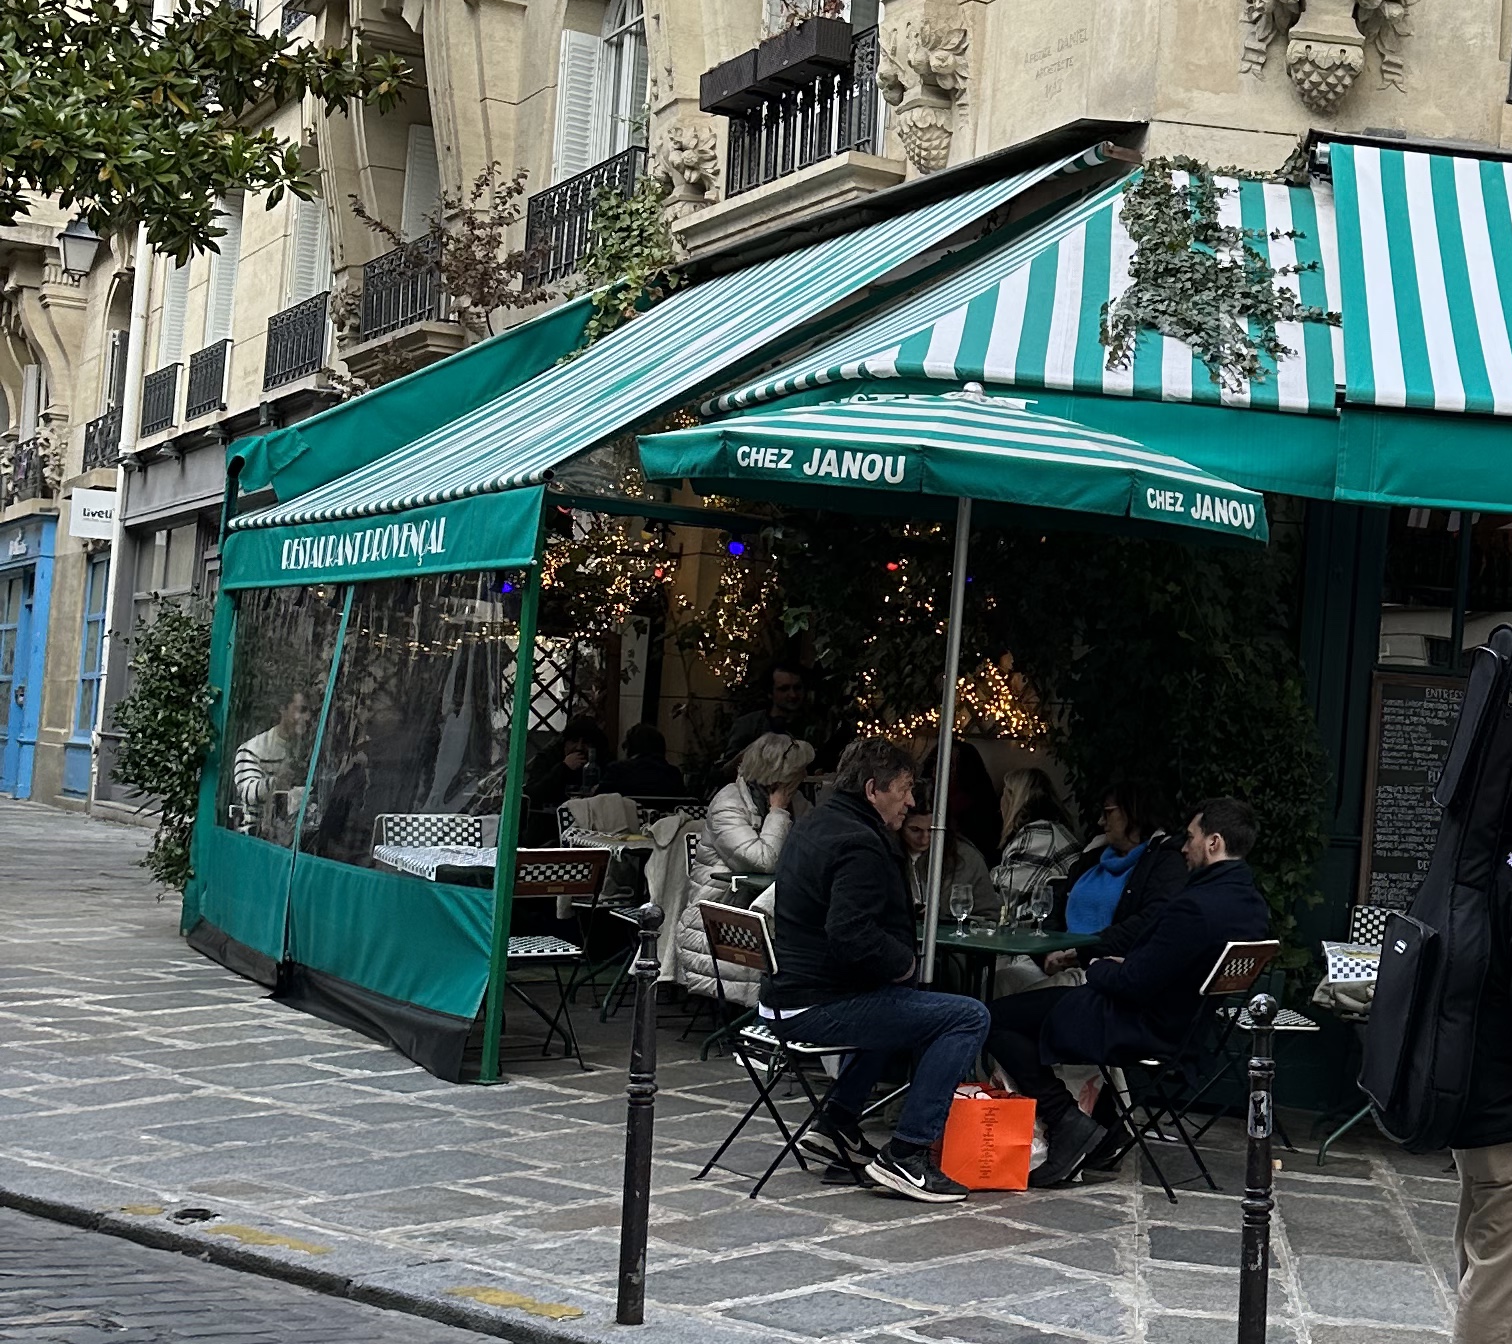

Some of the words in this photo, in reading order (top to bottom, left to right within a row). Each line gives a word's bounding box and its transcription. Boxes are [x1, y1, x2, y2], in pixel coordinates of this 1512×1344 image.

[736, 445, 794, 470] CHEZ
[803, 448, 906, 484] JANOU
[1146, 487, 1185, 512] CHEZ
[1190, 493, 1256, 530] JANOU
[281, 532, 364, 570] RESTAURANT
[362, 517, 447, 567] PROVENÇAL
